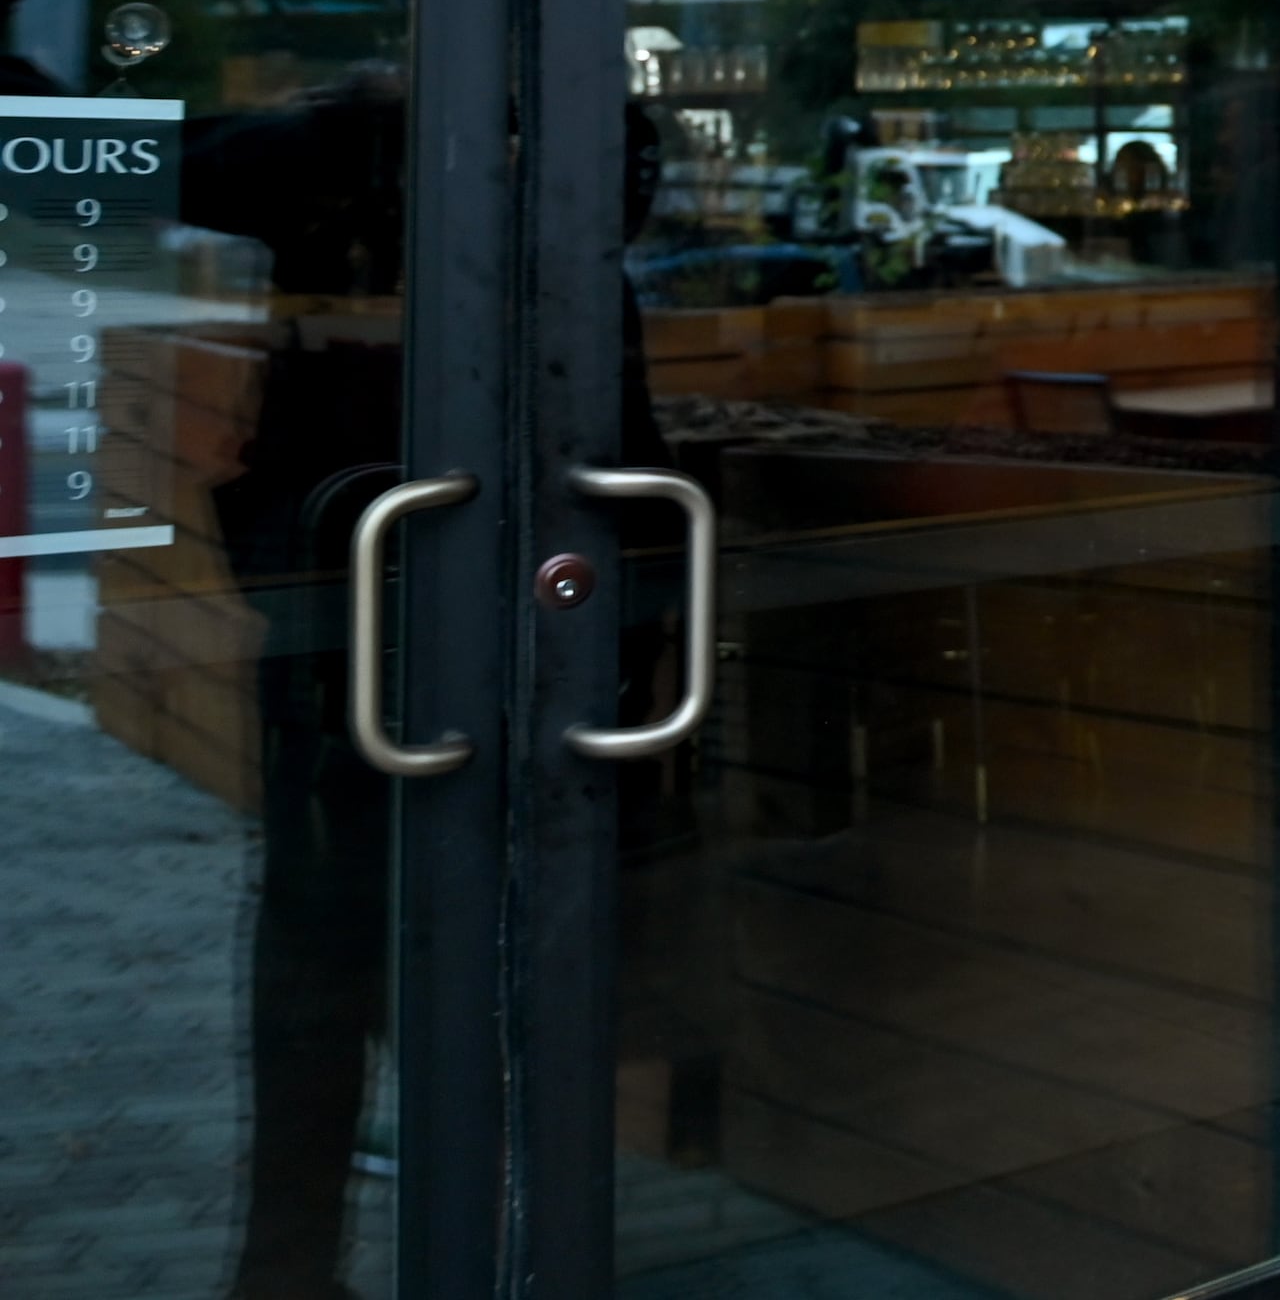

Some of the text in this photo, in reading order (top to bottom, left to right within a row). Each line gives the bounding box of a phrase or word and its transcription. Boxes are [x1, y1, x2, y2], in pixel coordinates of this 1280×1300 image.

[75, 198, 101, 227] 9
[73, 243, 98, 273] 9
[71, 289, 97, 318] 9
[69, 334, 96, 363] 9
[63, 380, 96, 409] 11
[63, 425, 96, 454] 11
[66, 470, 92, 500] 9
